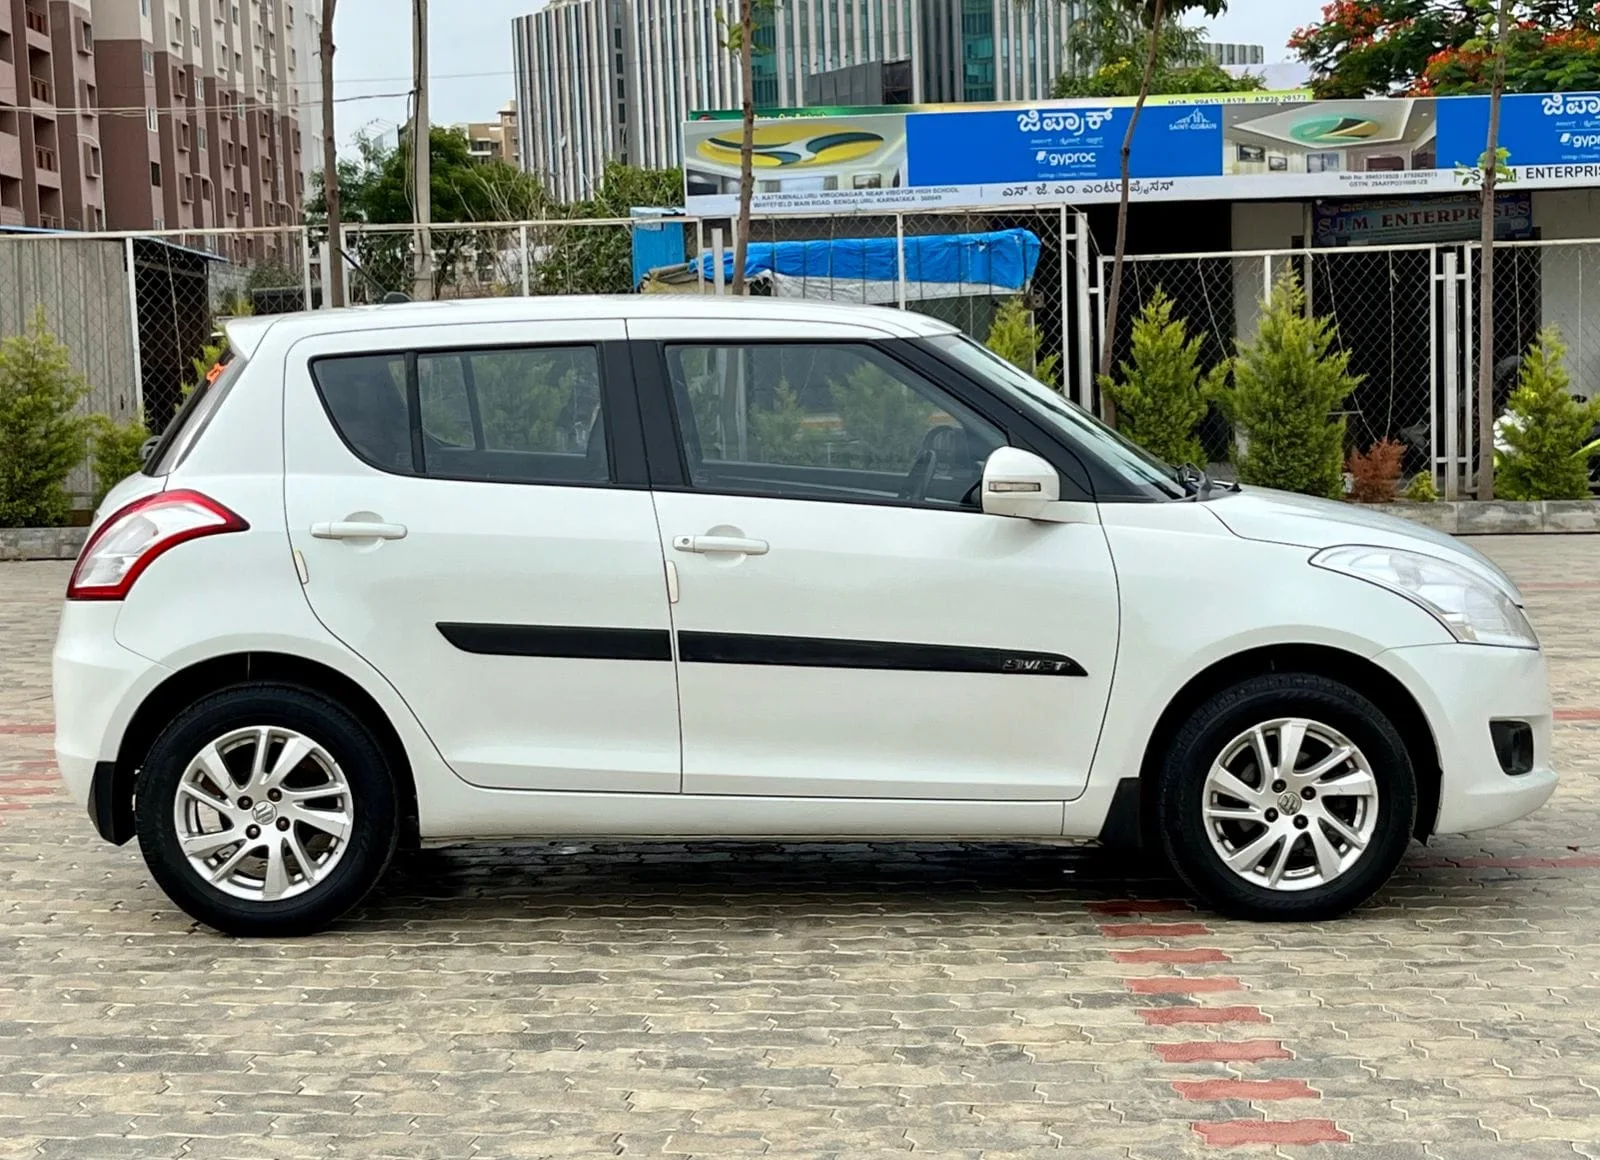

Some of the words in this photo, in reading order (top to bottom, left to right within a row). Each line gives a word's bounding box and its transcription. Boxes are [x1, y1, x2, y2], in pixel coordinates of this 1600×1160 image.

[1169, 122, 1217, 131] SAINT-GOBAIN
[1048, 152, 1097, 167] gyproc
[1526, 165, 1600, 179] ENTERPRI
[1381, 201, 1530, 228] ENTERPRSES
